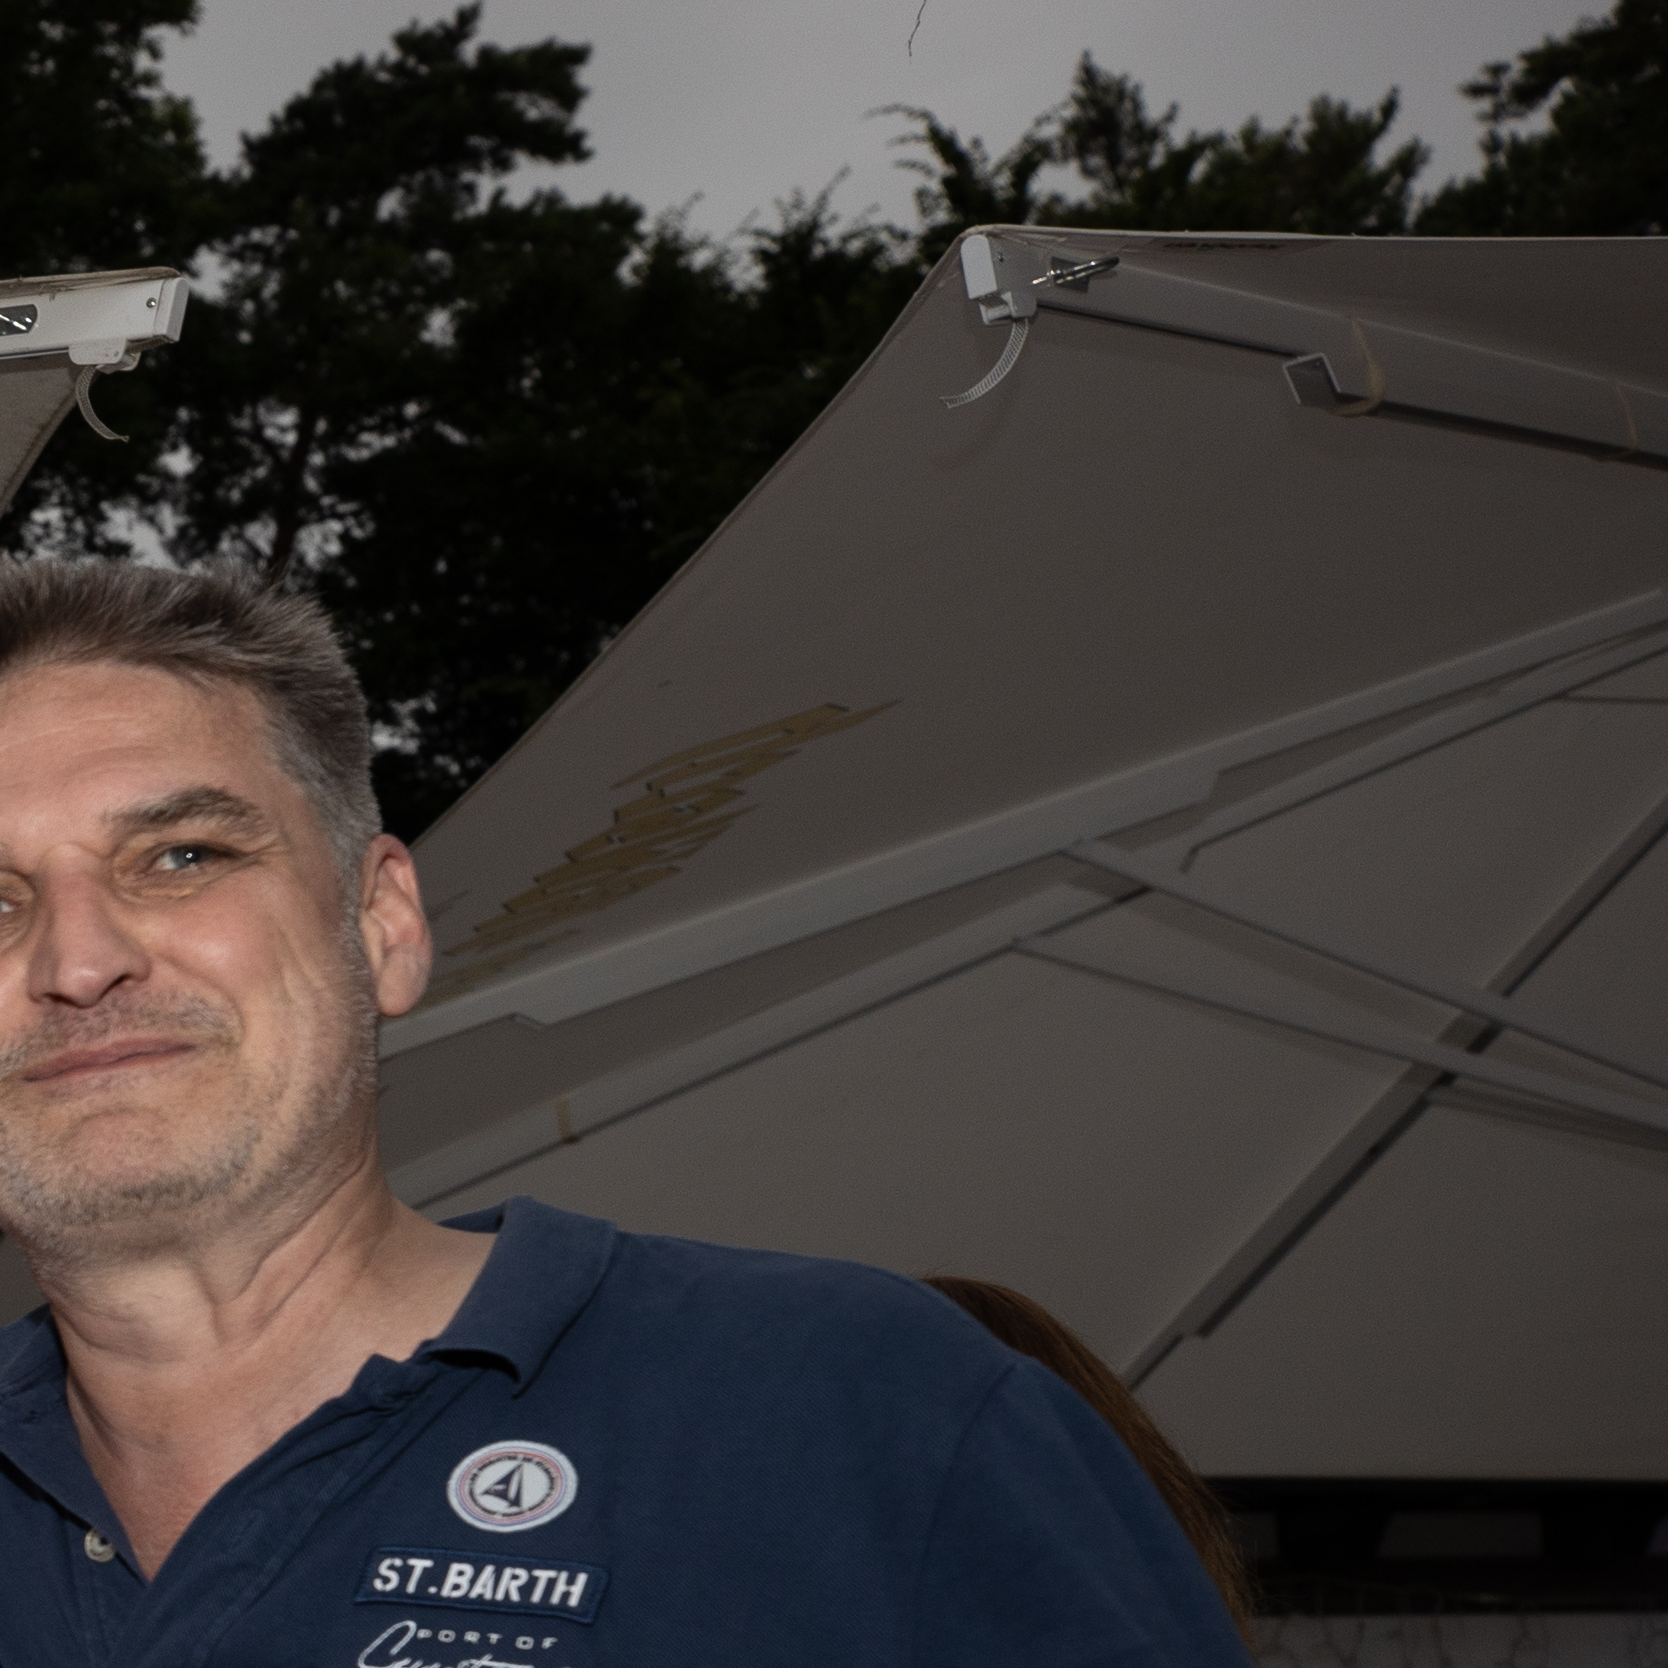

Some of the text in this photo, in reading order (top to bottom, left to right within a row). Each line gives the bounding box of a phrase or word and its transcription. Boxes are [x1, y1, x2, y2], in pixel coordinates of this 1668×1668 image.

[371, 1556, 590, 1609] ST.BARTH
[415, 1627, 560, 1650] PORT OF
